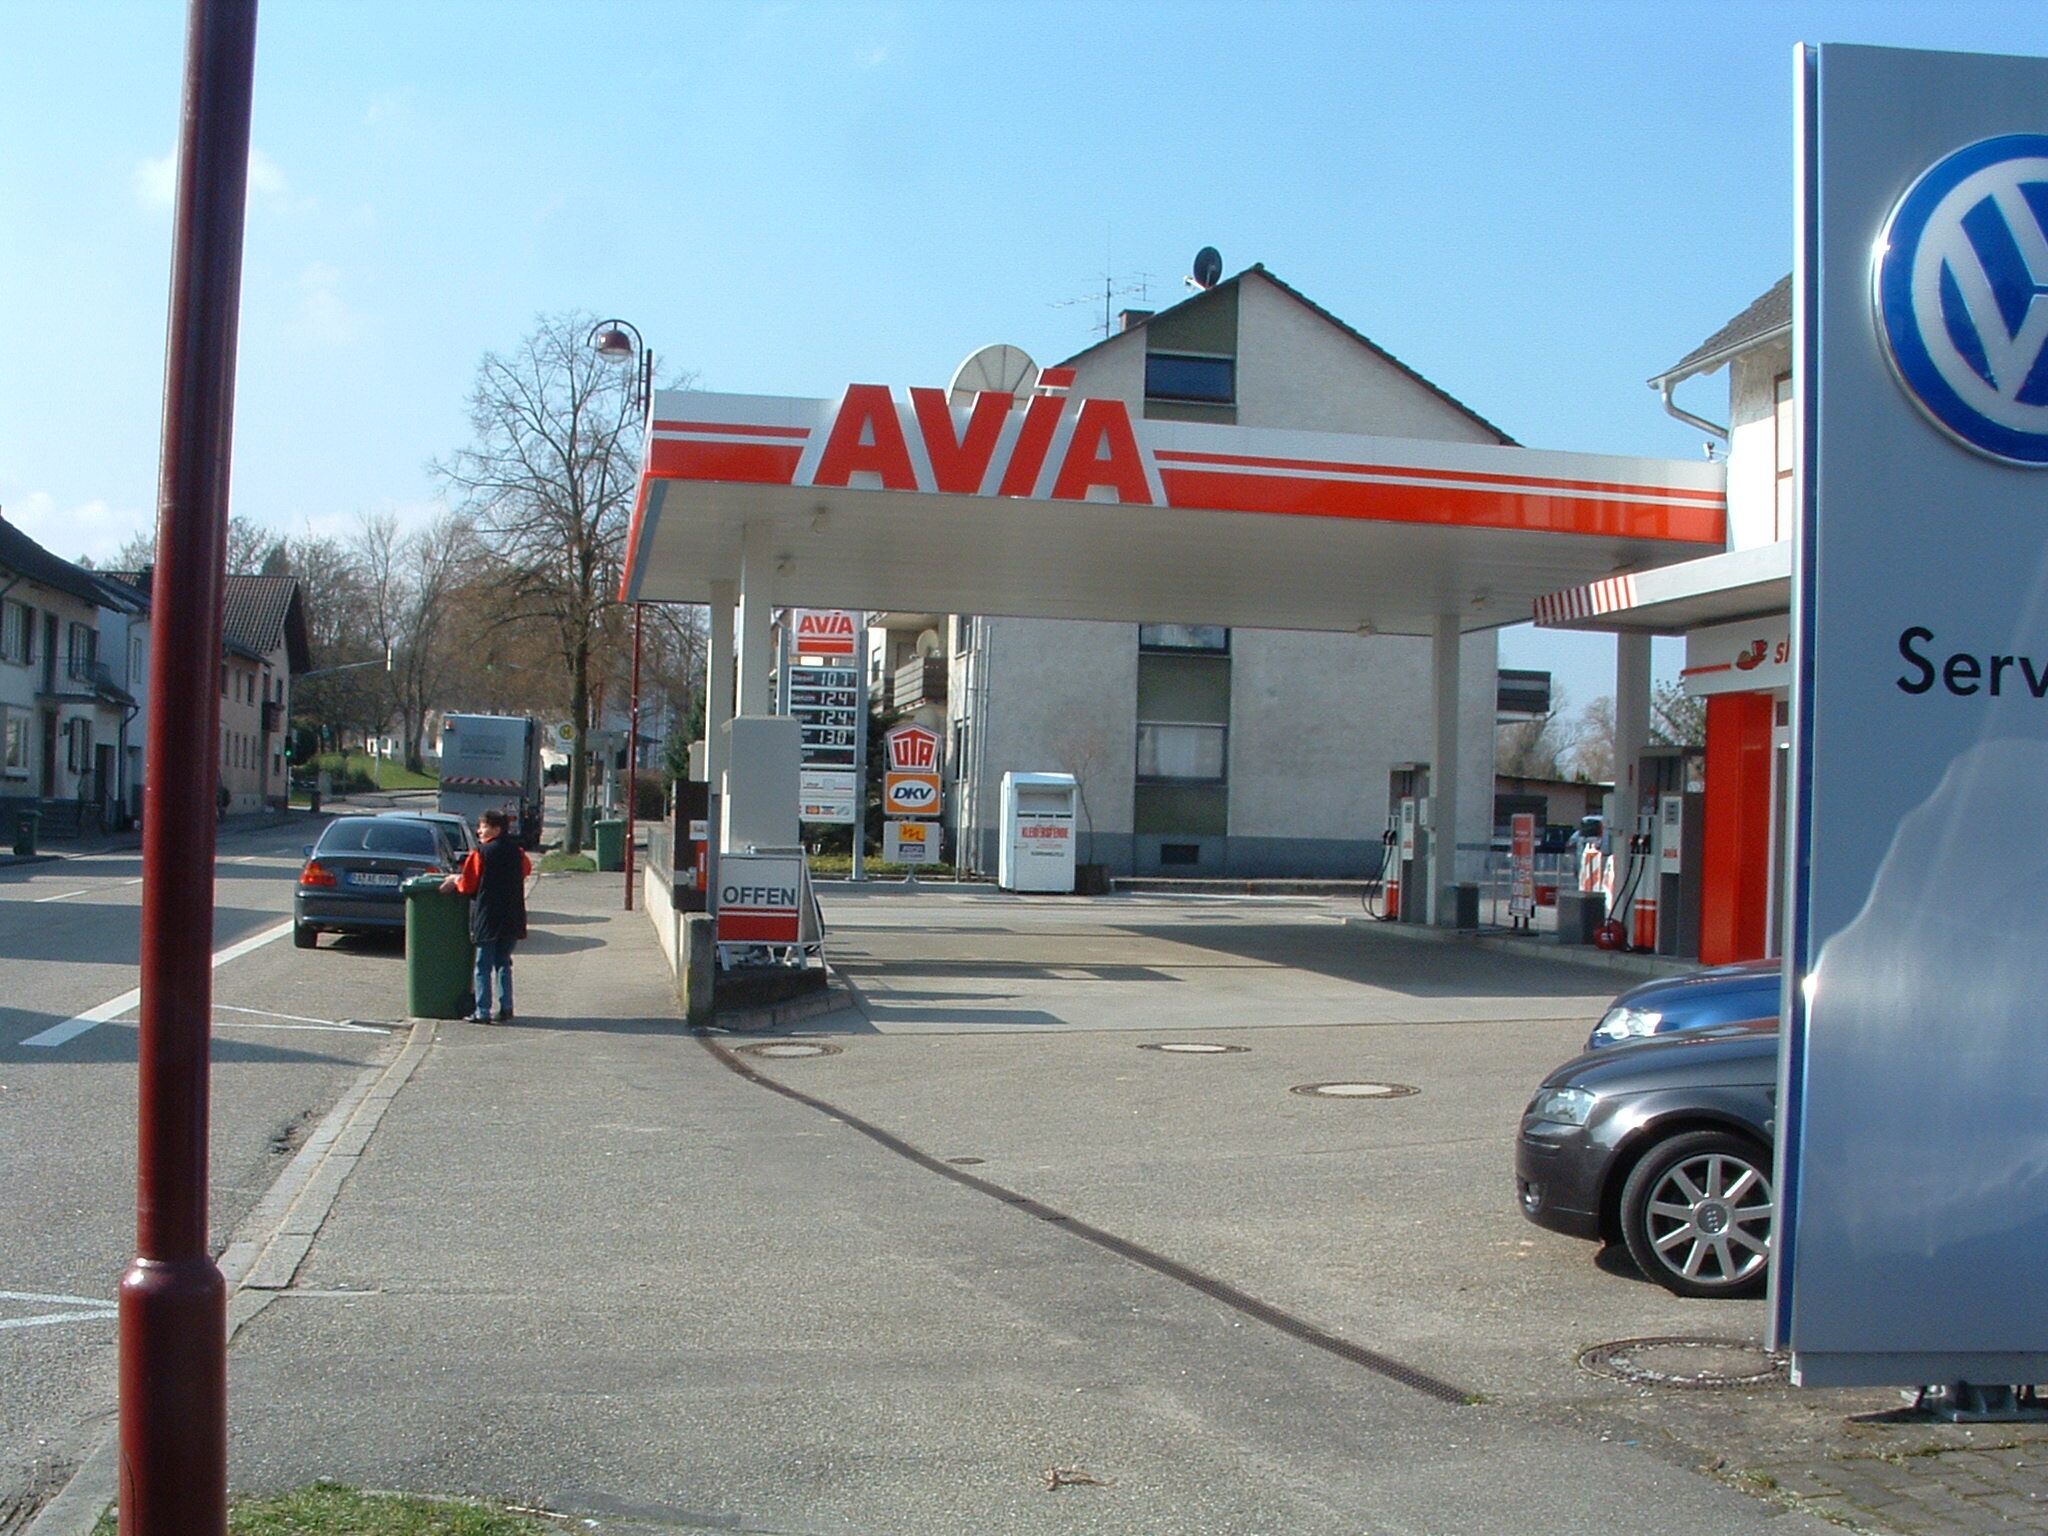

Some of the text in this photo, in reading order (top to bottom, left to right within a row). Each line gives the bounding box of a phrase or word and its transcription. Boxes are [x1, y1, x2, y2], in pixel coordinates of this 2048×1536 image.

[812, 367, 1154, 504] AVIA
[798, 612, 854, 634] AVIA
[819, 691, 848, 706] 124
[819, 710, 848, 725] 124
[818, 730, 847, 744] 130
[892, 727, 936, 767] UTA
[892, 786, 933, 799] DKV
[722, 885, 796, 906] OFFEN
